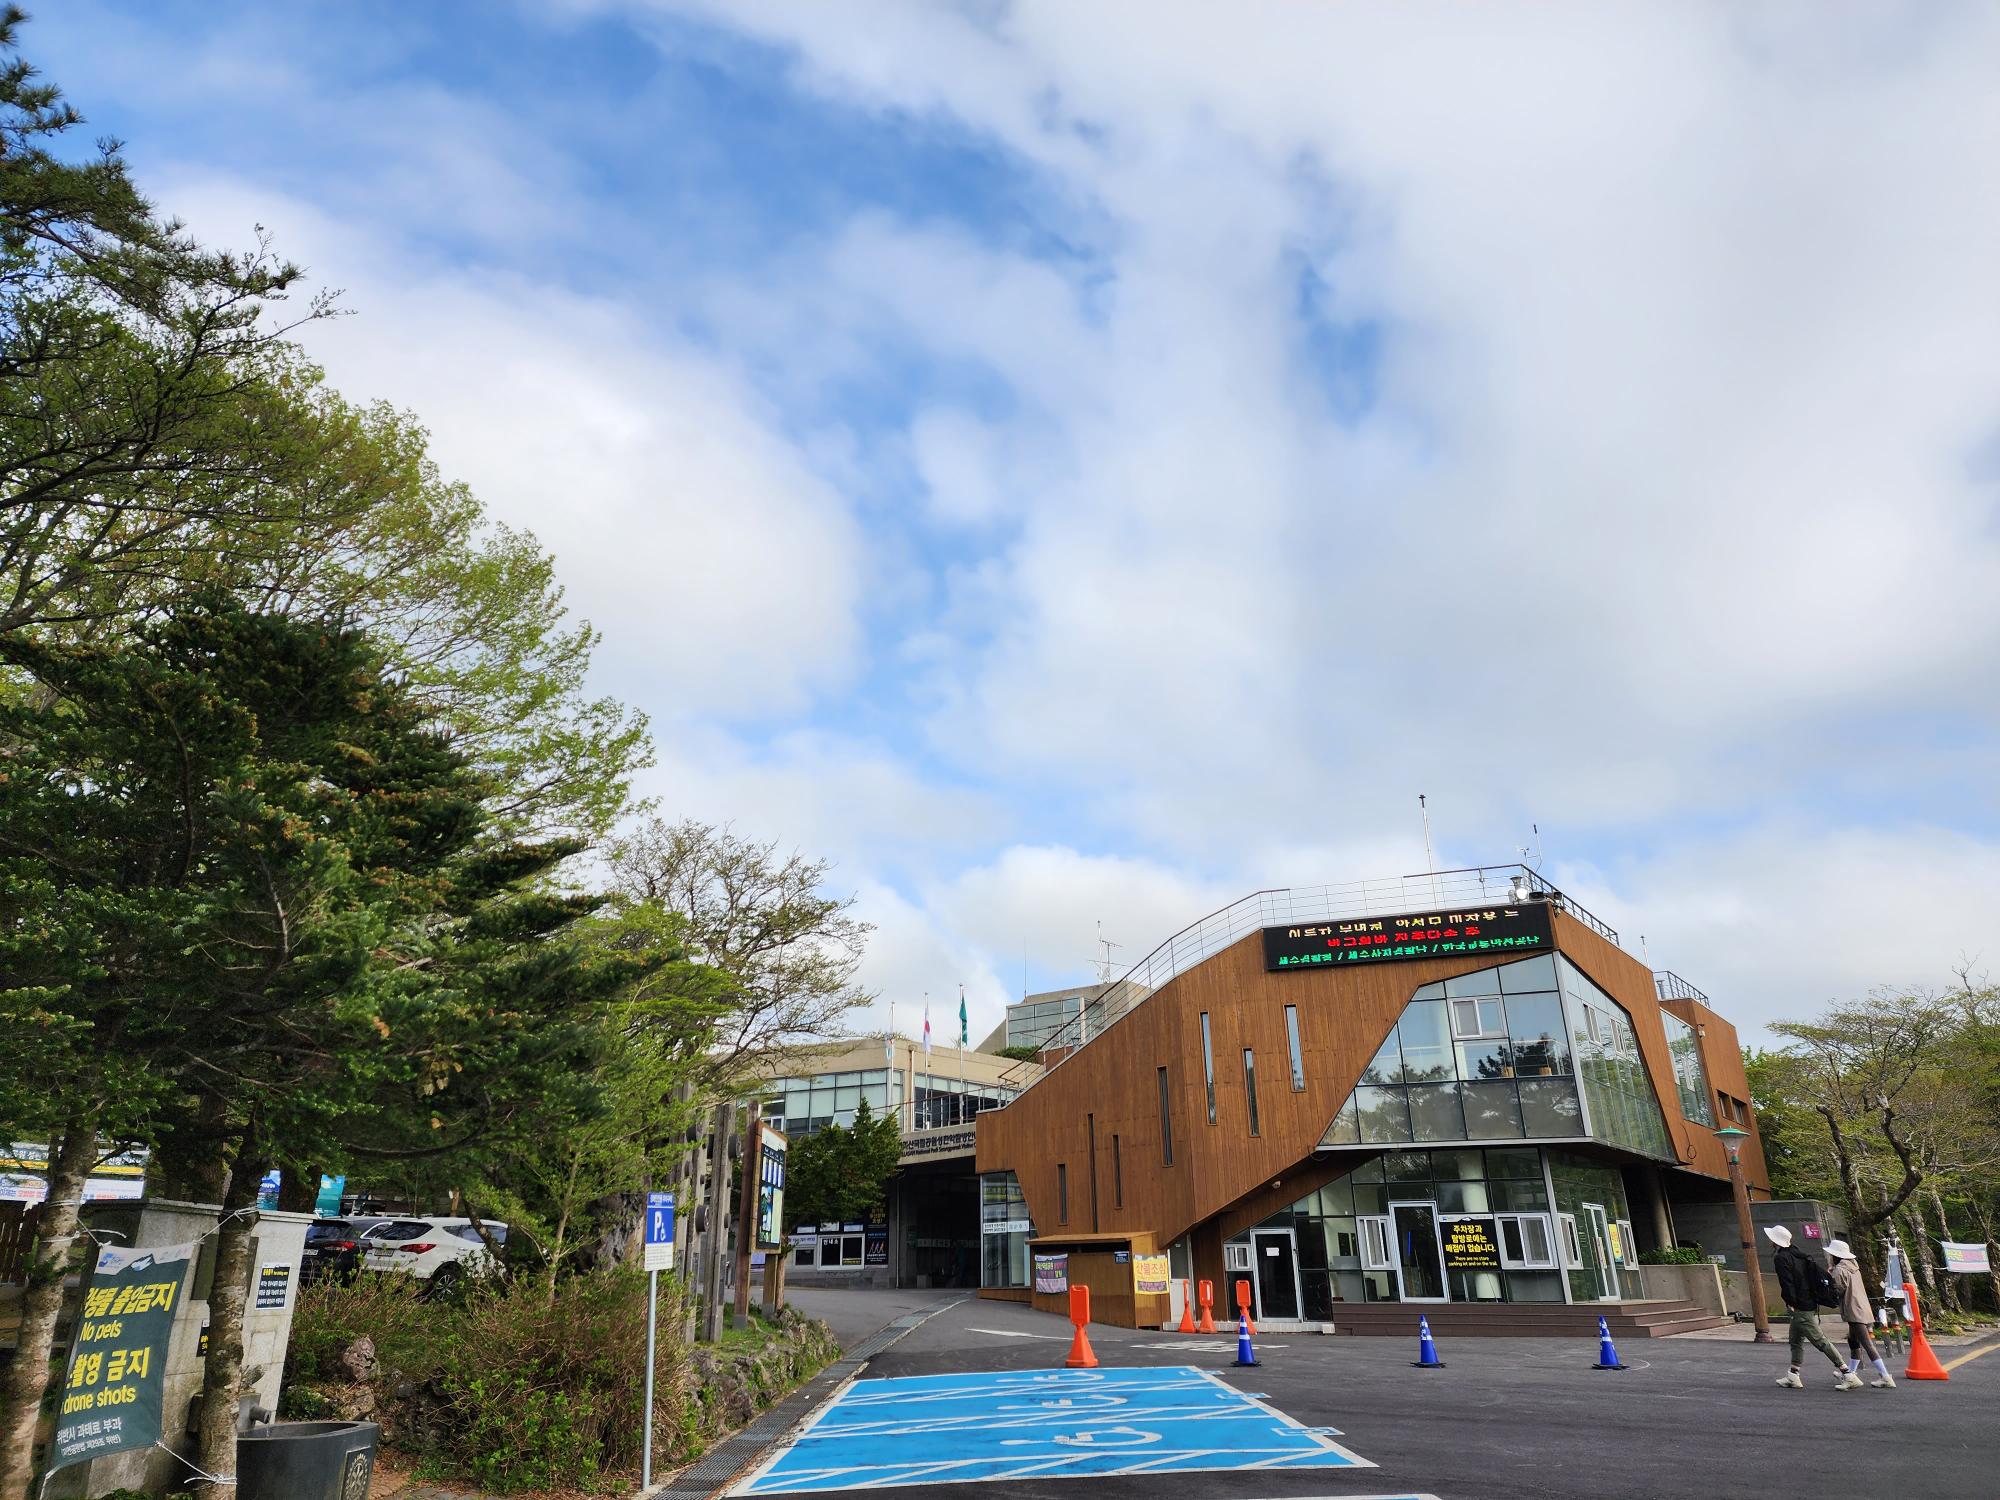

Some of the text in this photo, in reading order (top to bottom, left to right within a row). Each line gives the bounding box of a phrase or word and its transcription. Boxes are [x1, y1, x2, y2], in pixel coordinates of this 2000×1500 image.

[654, 1211, 662, 1242] P
[1453, 1225, 1482, 1234] 주차장과
[822, 1238, 839, 1246] 안내소
[1445, 1244, 1496, 1253] 매점이 없습니다.
[1451, 1234, 1487, 1243] 탐방로에는
[1136, 1262, 1167, 1276] 산불조심
[109, 1280, 178, 1316] 출입금지
[80, 1319, 123, 1342] No pets
[107, 1346, 151, 1382] 금지
[63, 1384, 137, 1415] drone shots
[77, 1420, 102, 1439] 과태료
[103, 1416, 122, 1433] 부과
